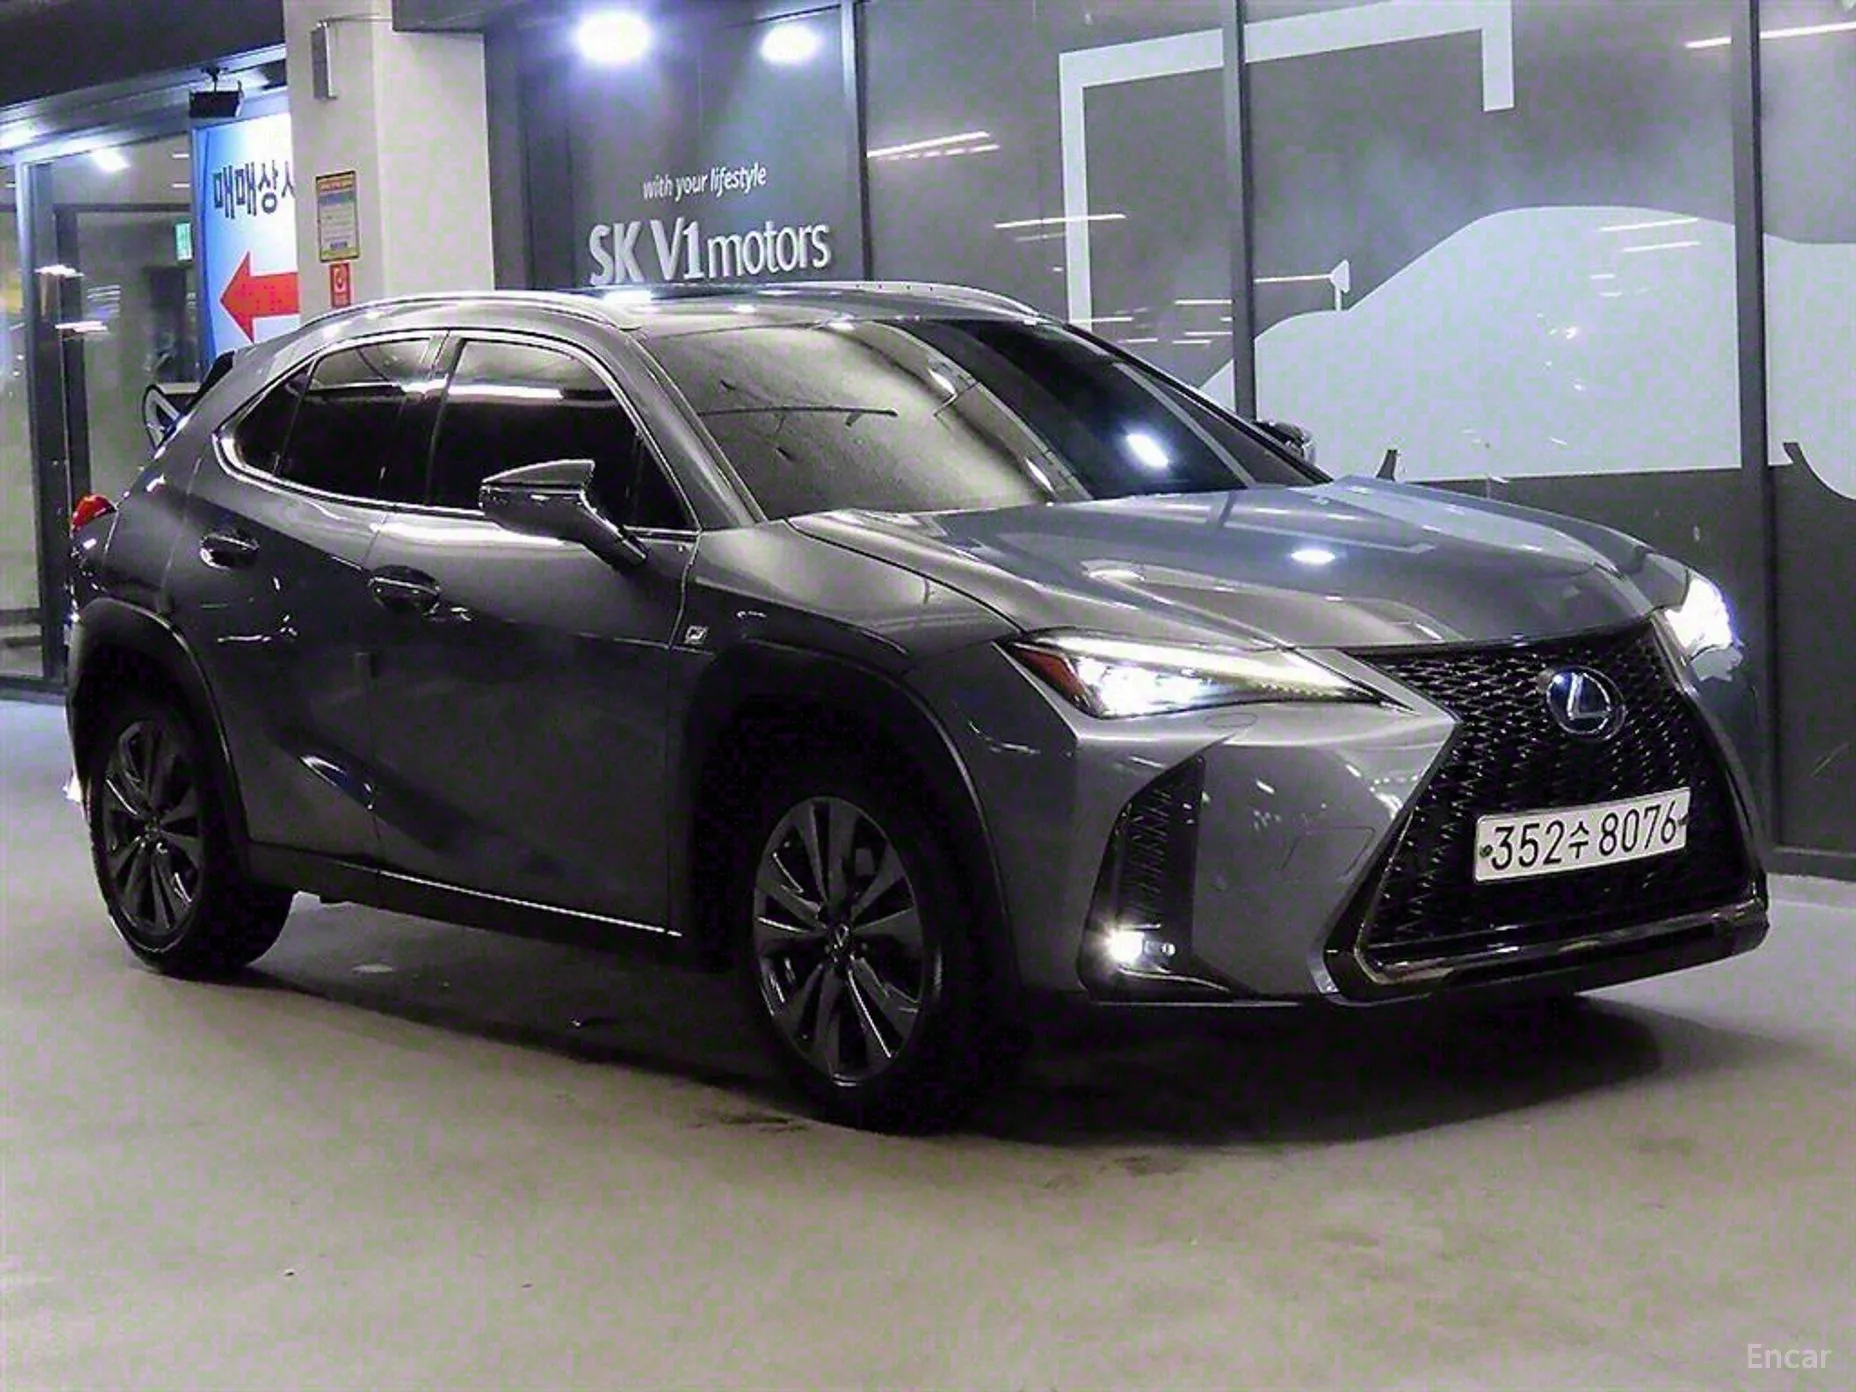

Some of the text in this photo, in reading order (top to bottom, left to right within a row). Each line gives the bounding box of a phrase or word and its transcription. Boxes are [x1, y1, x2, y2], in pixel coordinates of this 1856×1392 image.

[643, 161, 767, 202] with your lifestyle
[589, 220, 645, 286] SK
